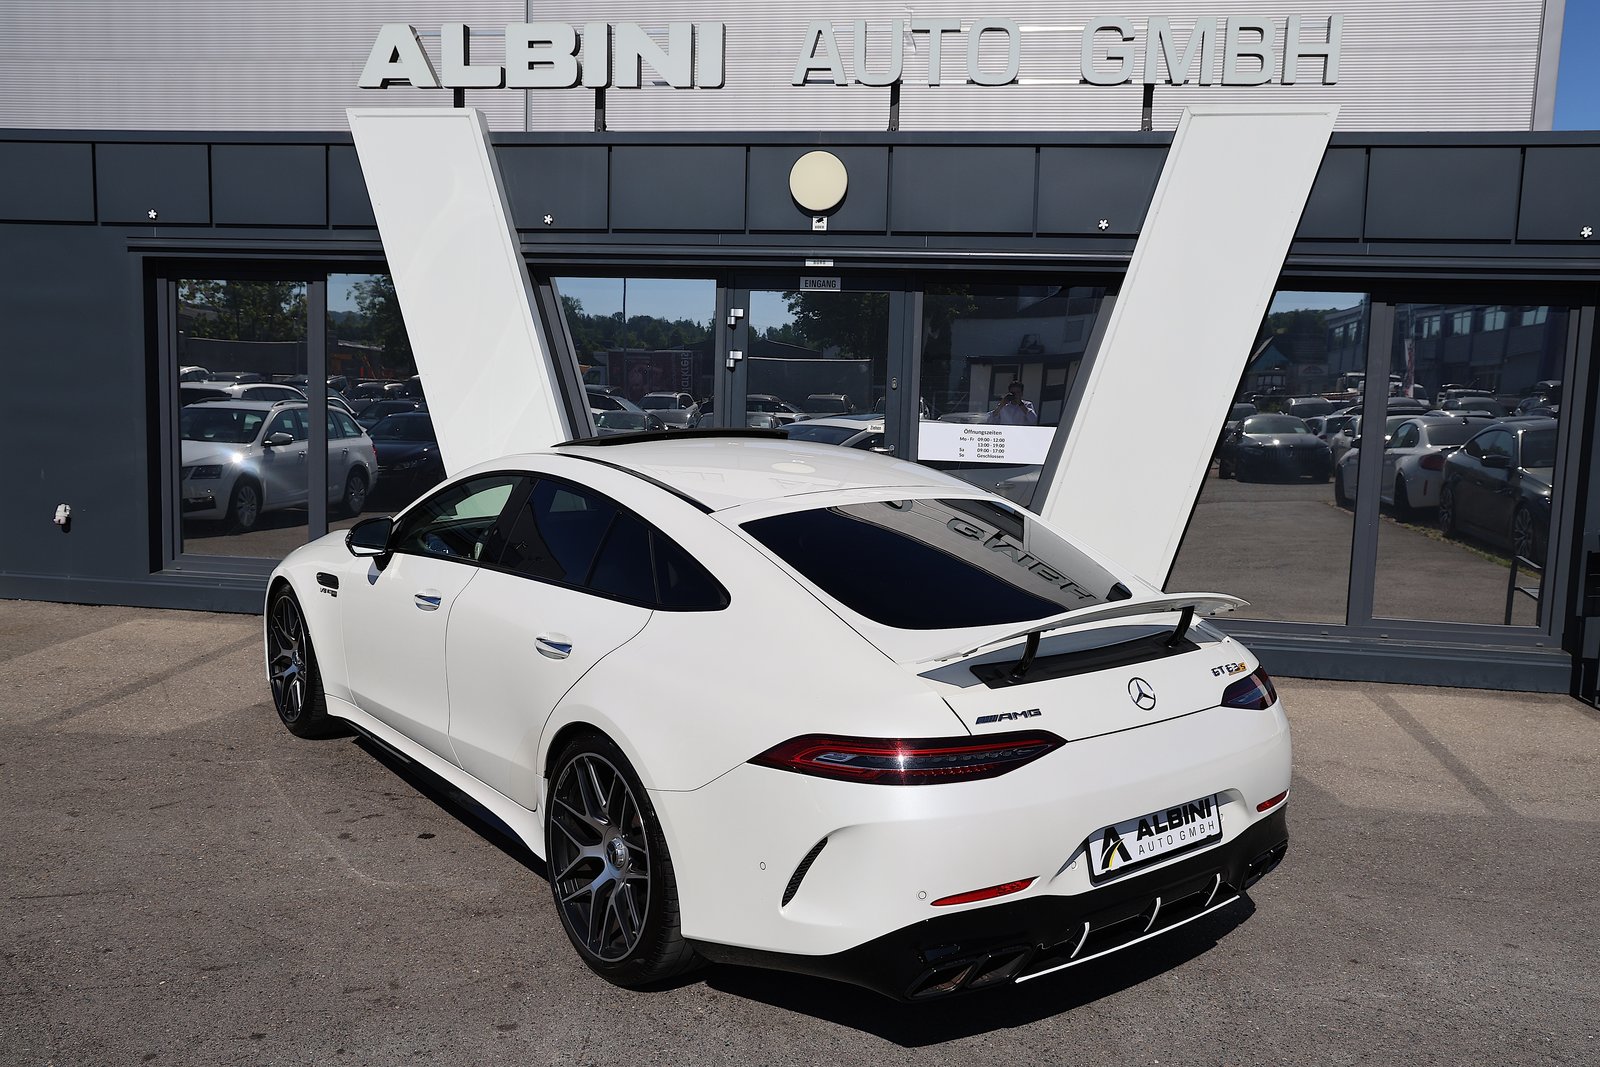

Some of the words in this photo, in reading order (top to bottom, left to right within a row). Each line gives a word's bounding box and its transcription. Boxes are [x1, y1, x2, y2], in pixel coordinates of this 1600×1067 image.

[357, 23, 727, 89] ALBINI
[792, 17, 1021, 86] AUTO
[1080, 14, 1345, 86] GMBH
[804, 279, 837, 288] EINGANG
[963, 428, 1003, 436] Öffnungszeiten
[998, 708, 1043, 722] AMG
[1136, 798, 1212, 841] ALBINI
[1138, 834, 1174, 855] AUTO
[1179, 821, 1215, 841] GMBH
